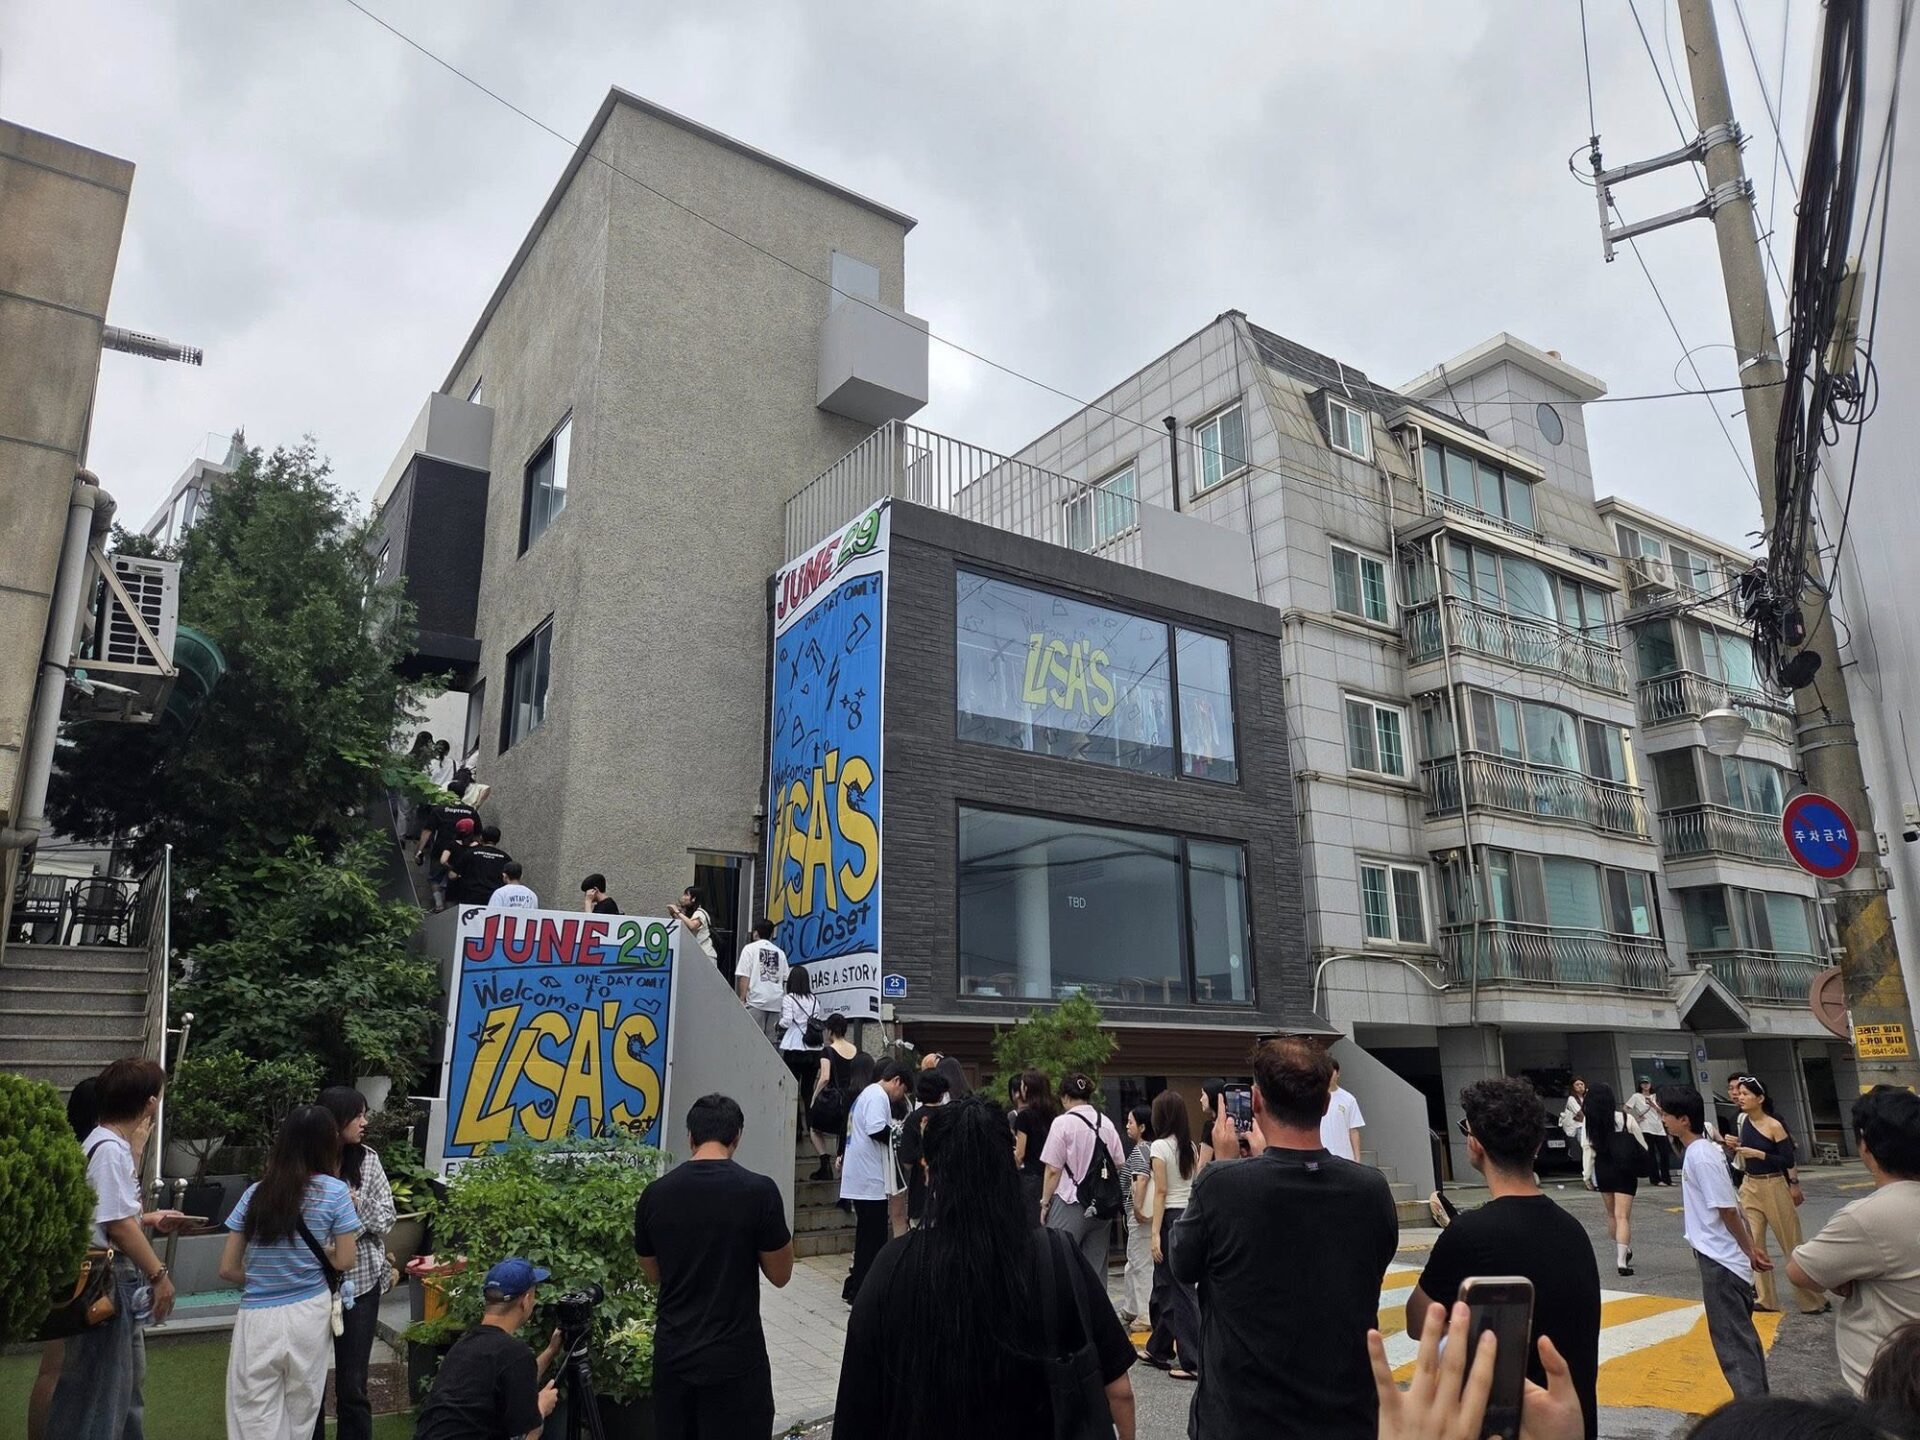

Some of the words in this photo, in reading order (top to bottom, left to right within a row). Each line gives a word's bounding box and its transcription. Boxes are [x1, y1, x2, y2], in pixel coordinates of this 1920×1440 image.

[777, 535, 842, 620] JUNE
[837, 507, 881, 566] 29
[1022, 632, 1116, 717] LISA'S
[767, 748, 880, 925] LISA'S
[1794, 828, 1848, 844] 주차금지
[1067, 895, 1087, 909] TBD
[464, 913, 610, 965] JUNE
[617, 921, 670, 967] 29
[800, 902, 871, 958] Closet
[473, 974, 580, 1013] Welcome
[585, 980, 611, 1003] to
[574, 974, 602, 985] ONE
[606, 975, 633, 986] DAY
[636, 976, 666, 989] ONLY
[811, 969, 830, 989] HAS
[832, 969, 840, 985] A
[842, 964, 877, 983] STORY
[890, 978, 900, 987] 25
[452, 1000, 661, 1147] LISA'S
